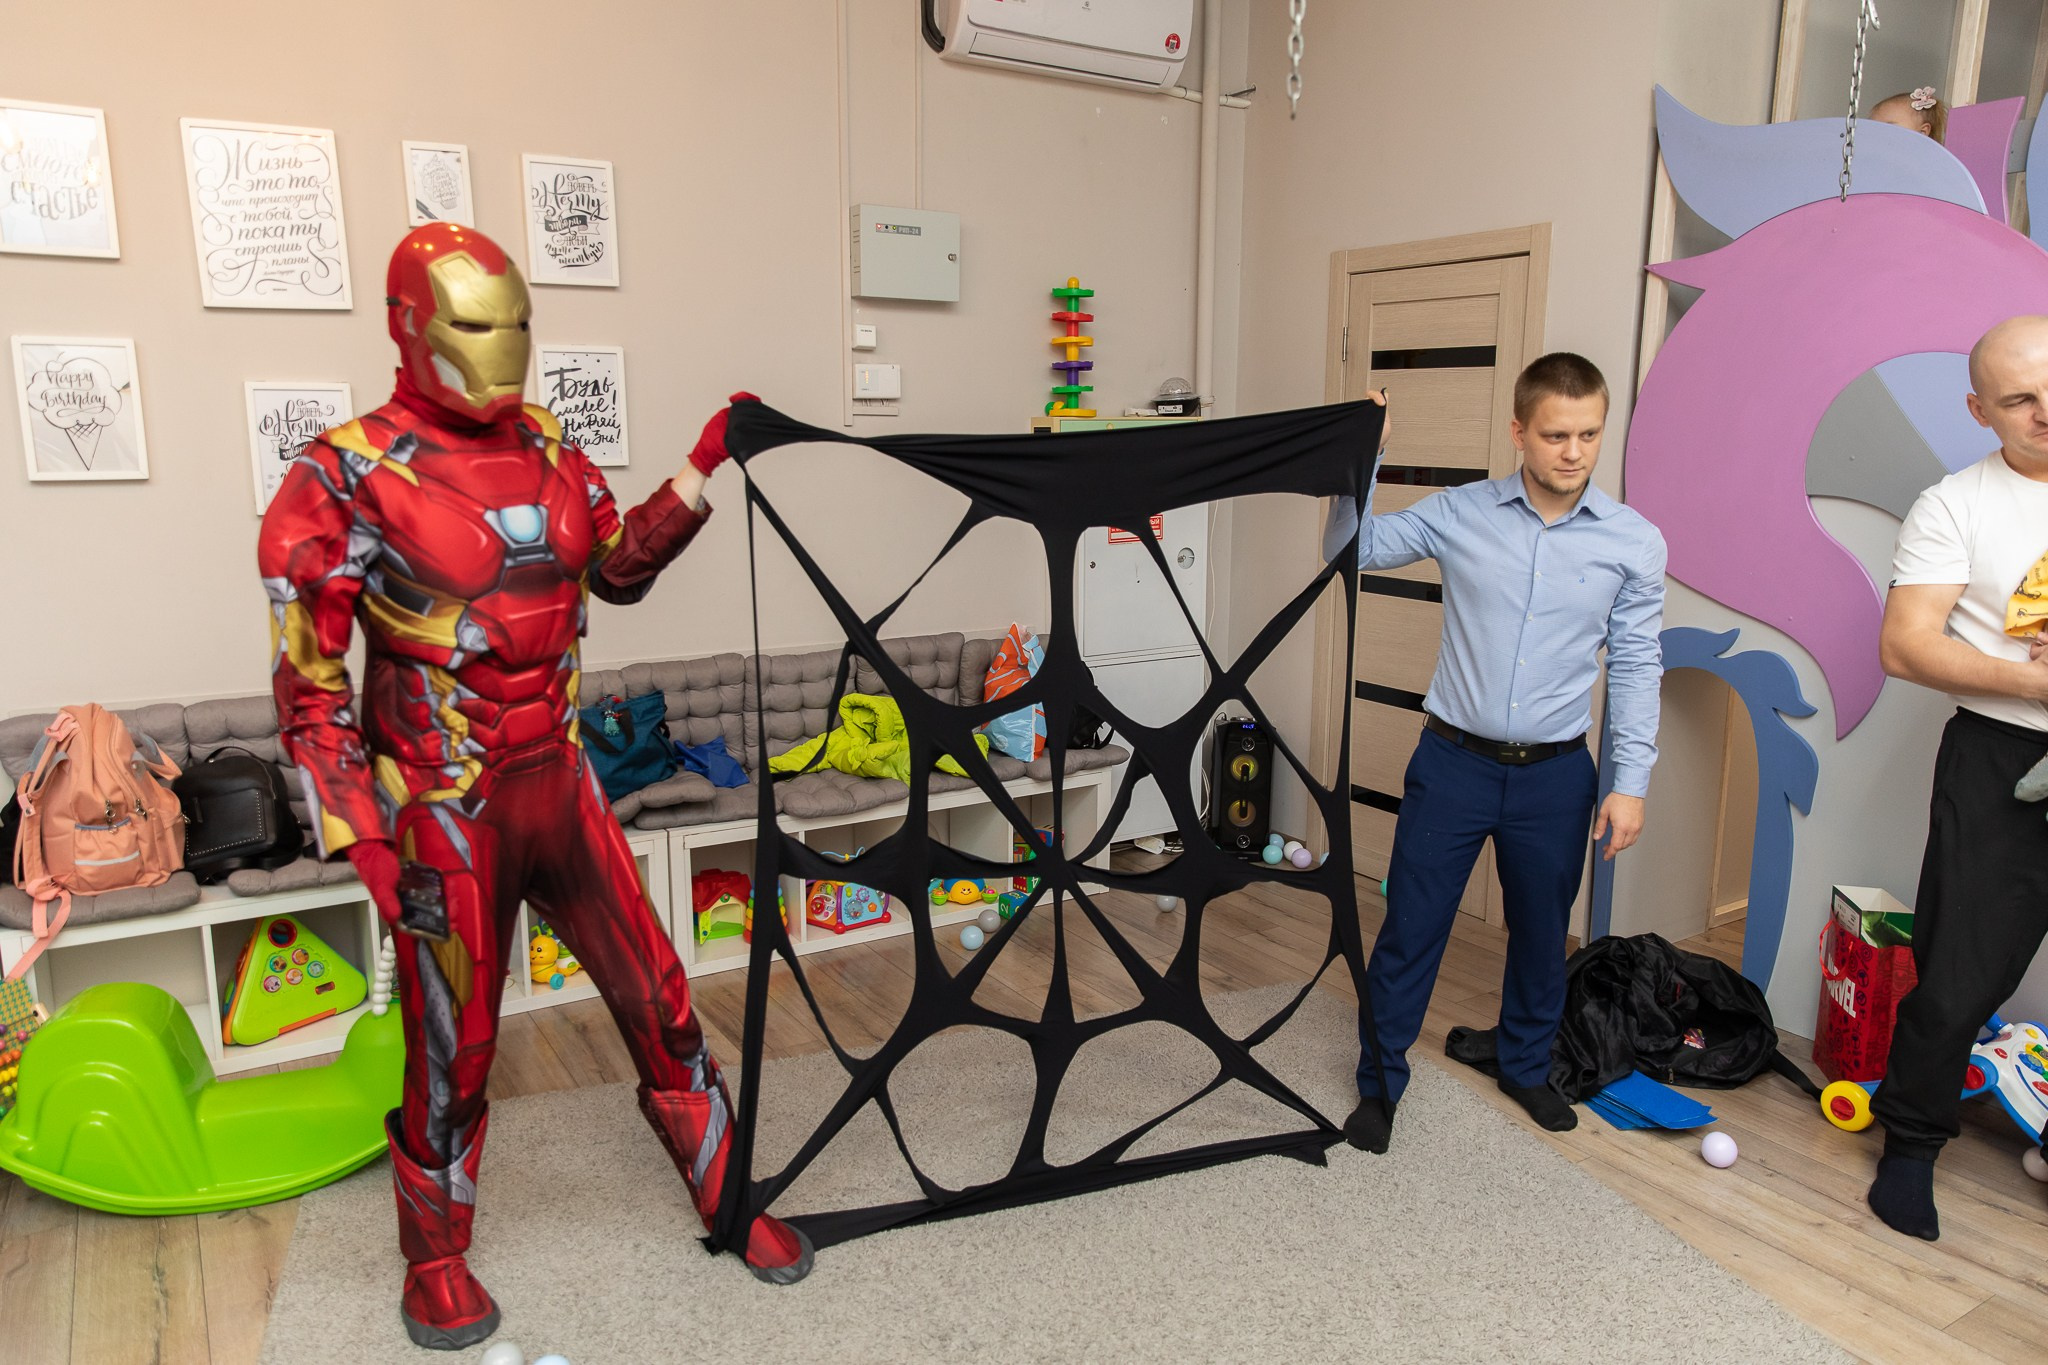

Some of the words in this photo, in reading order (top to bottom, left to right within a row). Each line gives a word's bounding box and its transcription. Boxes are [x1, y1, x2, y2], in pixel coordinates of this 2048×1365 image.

[245, 178, 285, 192] это
[221, 198, 246, 207] что
[249, 193, 318, 209] происходит
[238, 225, 285, 240] пока
[289, 222, 322, 239] ты
[234, 243, 302, 257] строишь
[271, 256, 310, 267] планы
[544, 367, 615, 401] Будь
